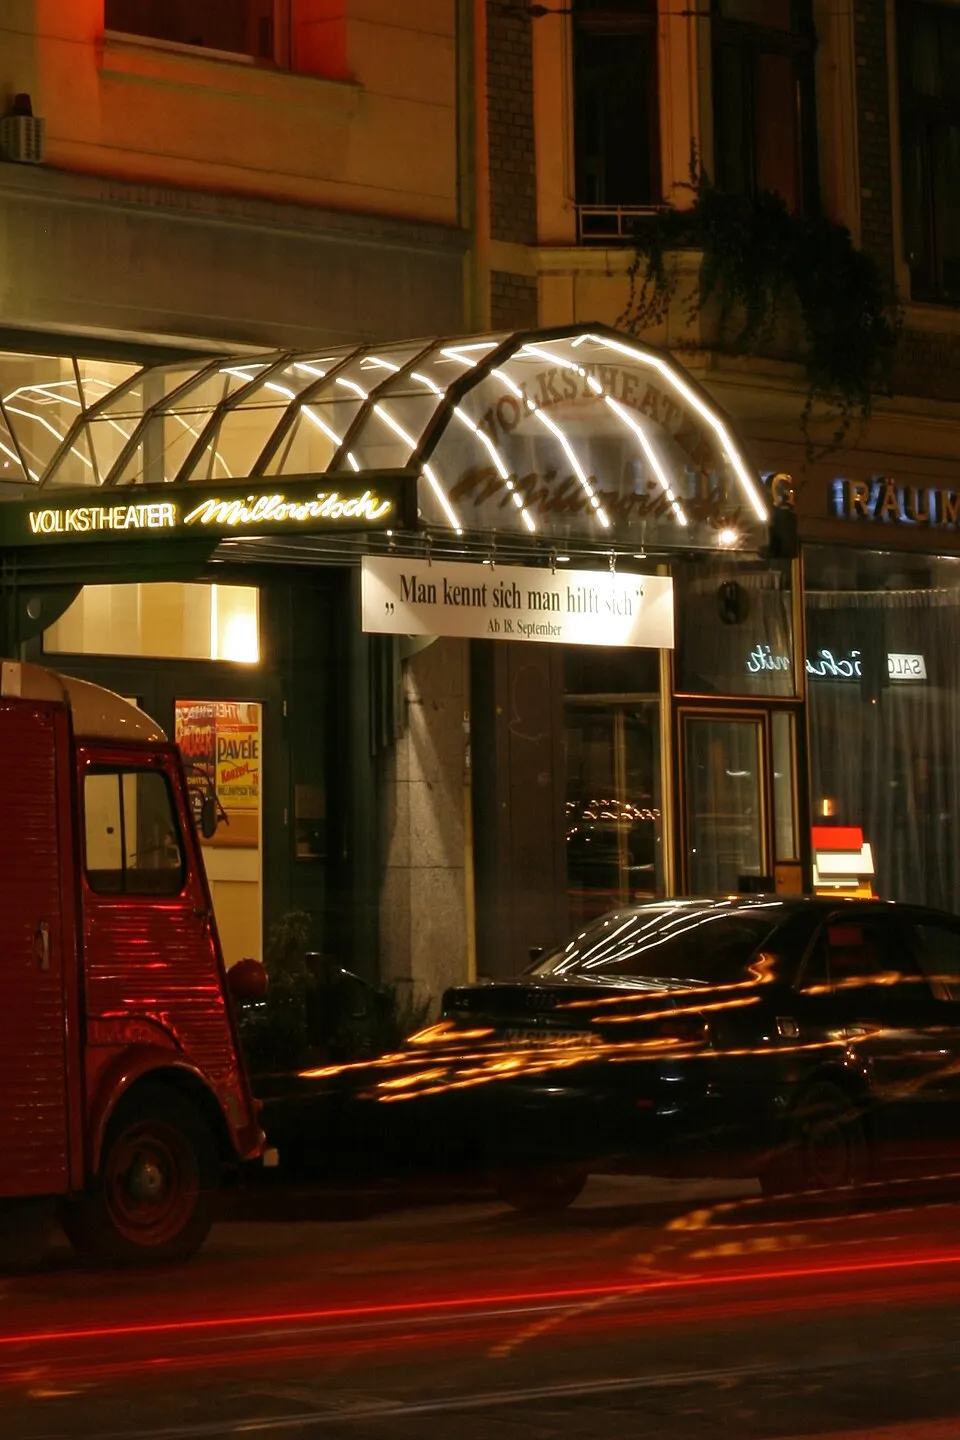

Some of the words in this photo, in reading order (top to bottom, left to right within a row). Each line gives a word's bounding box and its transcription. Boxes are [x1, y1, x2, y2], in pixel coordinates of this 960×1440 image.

[29, 502, 176, 533] VOLKSTHEATER
[183, 490, 391, 527] Millowitsch
[442, 577, 488, 608] kennt
[492, 580, 522, 610] sich
[527, 589, 561, 612] man
[566, 585, 600, 614] hilft
[486, 618, 501, 634] Ab
[516, 620, 563, 639] September
